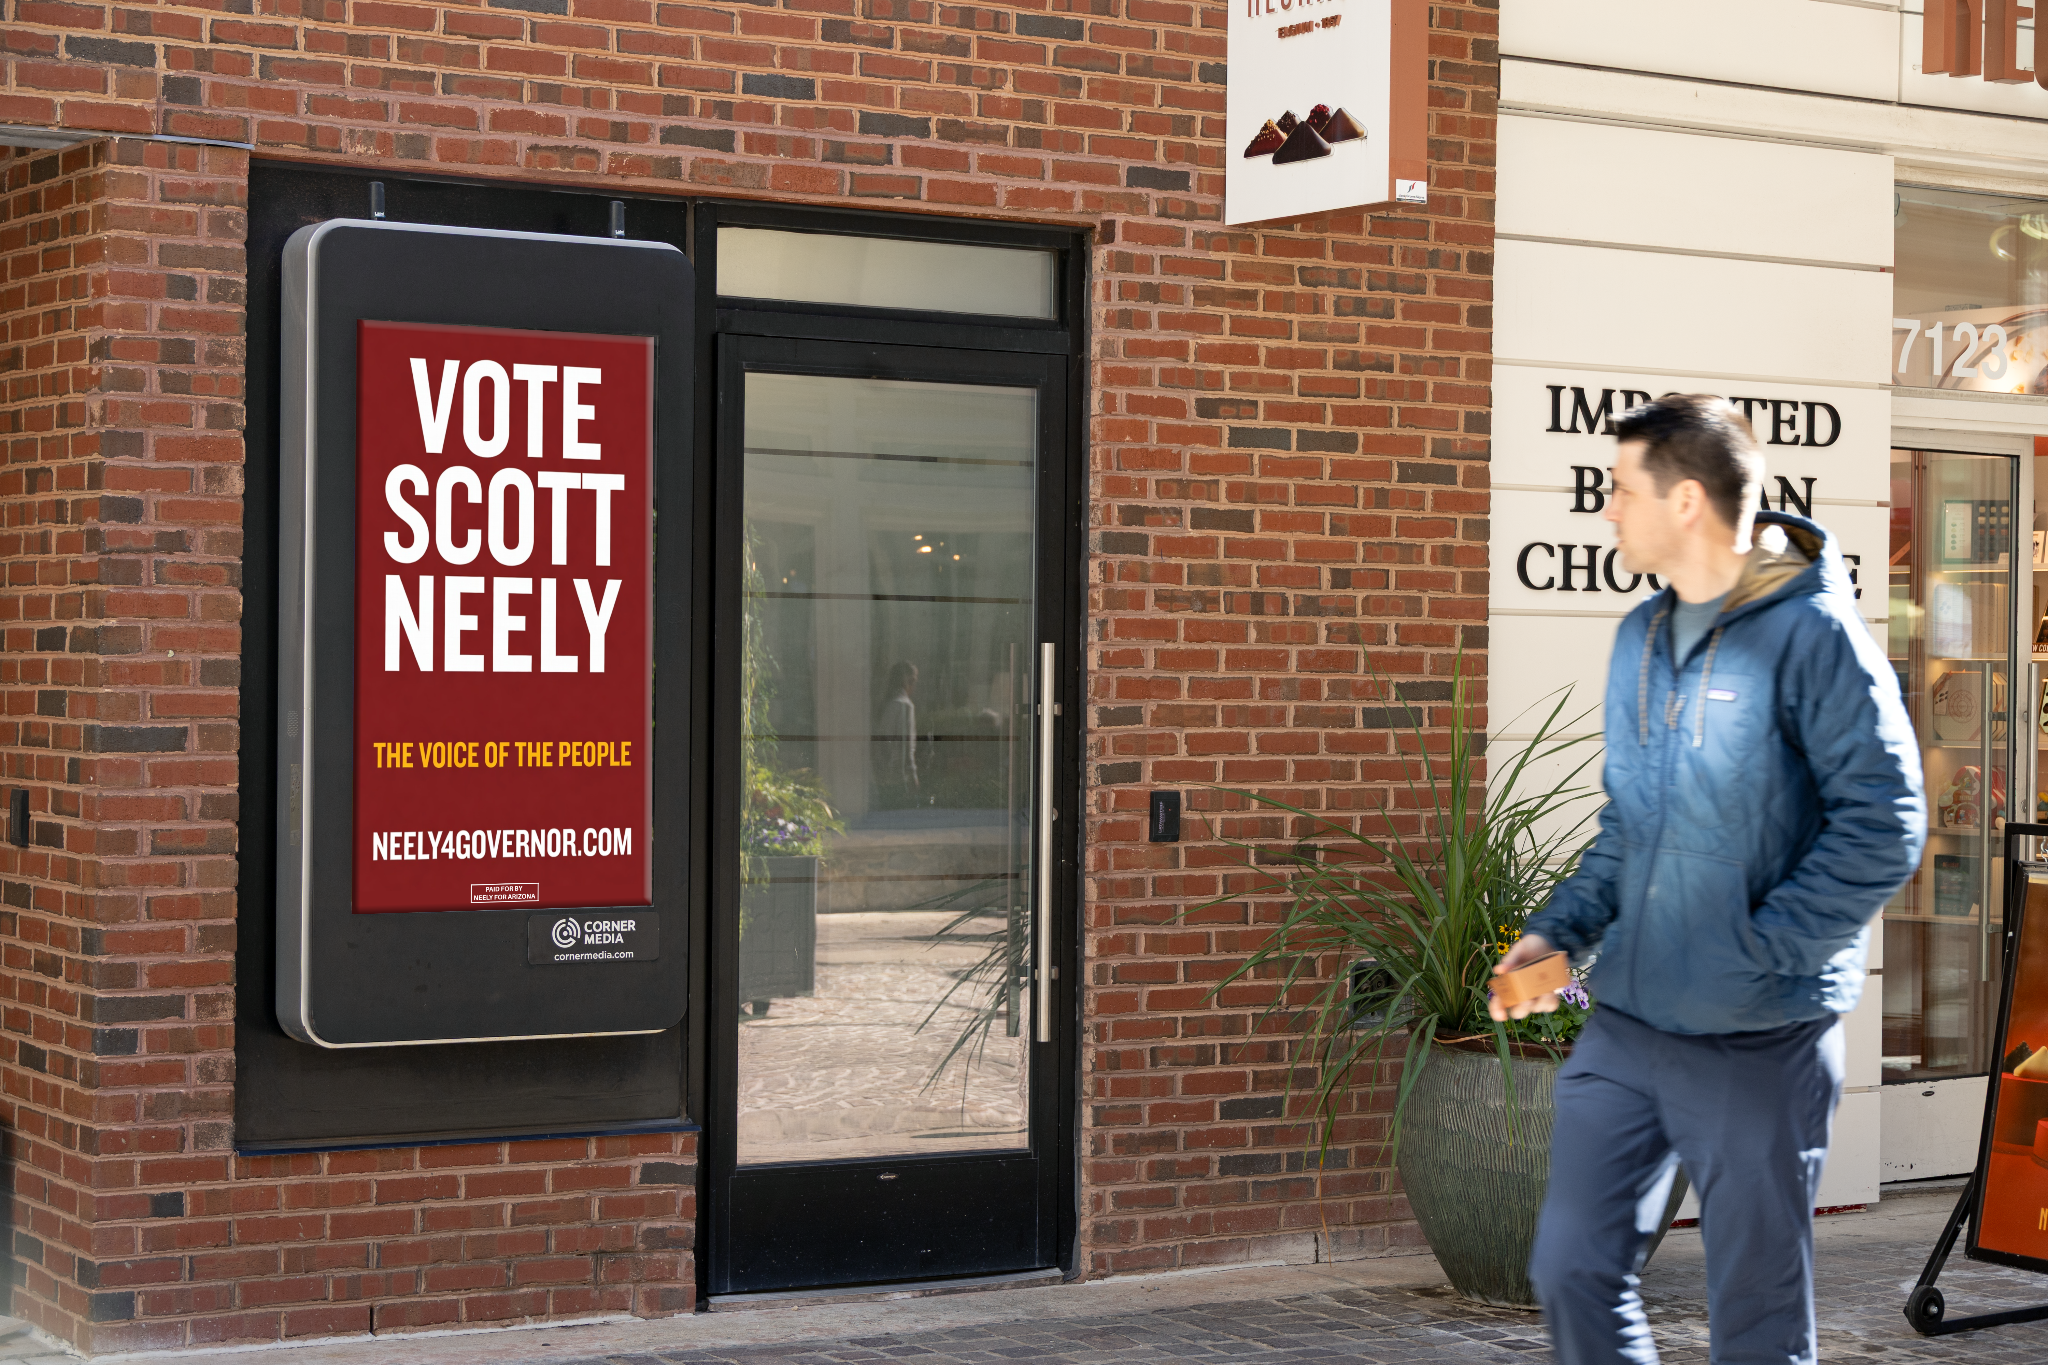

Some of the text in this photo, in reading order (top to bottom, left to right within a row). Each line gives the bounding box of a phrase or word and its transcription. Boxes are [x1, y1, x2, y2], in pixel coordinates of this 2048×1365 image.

[1892, 317, 2008, 381] 7123
[409, 357, 602, 461] VOTE
[1545, 385, 1842, 448] IMTED
[383, 463, 626, 567] SCOTT
[384, 574, 623, 673] NEELY
[373, 741, 632, 769] THE VOICE OF THE PEOPLE
[372, 827, 632, 862] NEELY4GOVERNOR.COM
[584, 919, 636, 933] CORNER
[584, 932, 624, 945] MEDIA
[554, 949, 634, 961] cornermedia.com
